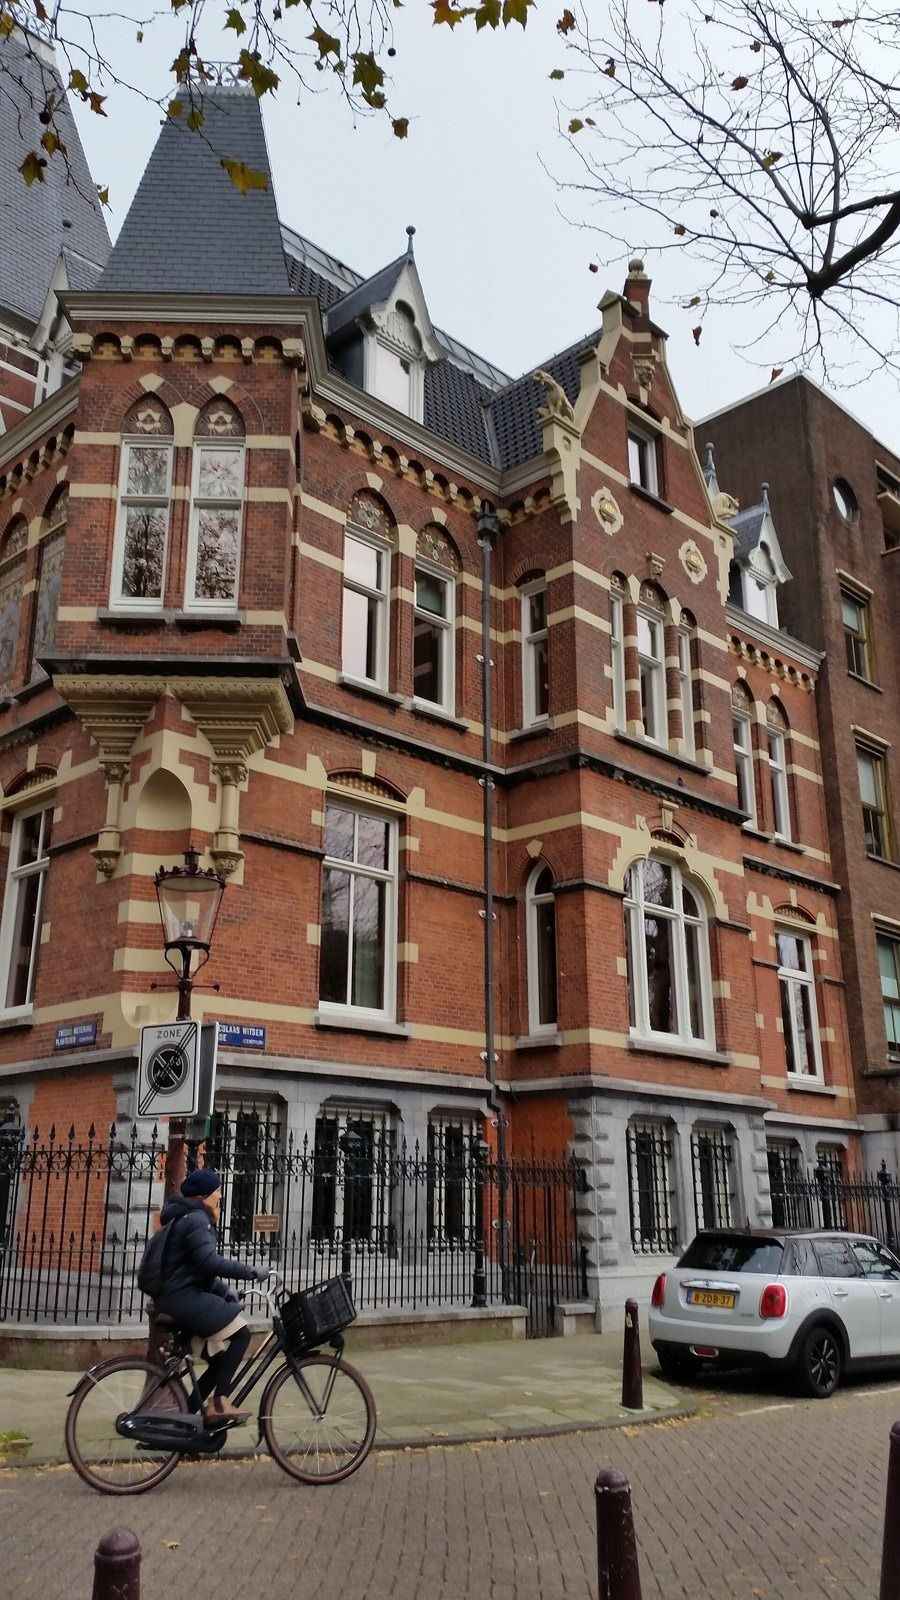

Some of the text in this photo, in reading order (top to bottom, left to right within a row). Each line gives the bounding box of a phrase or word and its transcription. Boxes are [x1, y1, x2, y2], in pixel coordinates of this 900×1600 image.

[157, 1029, 182, 1039] ZONE
[218, 1024, 264, 1037] COLAAS WITSEN
